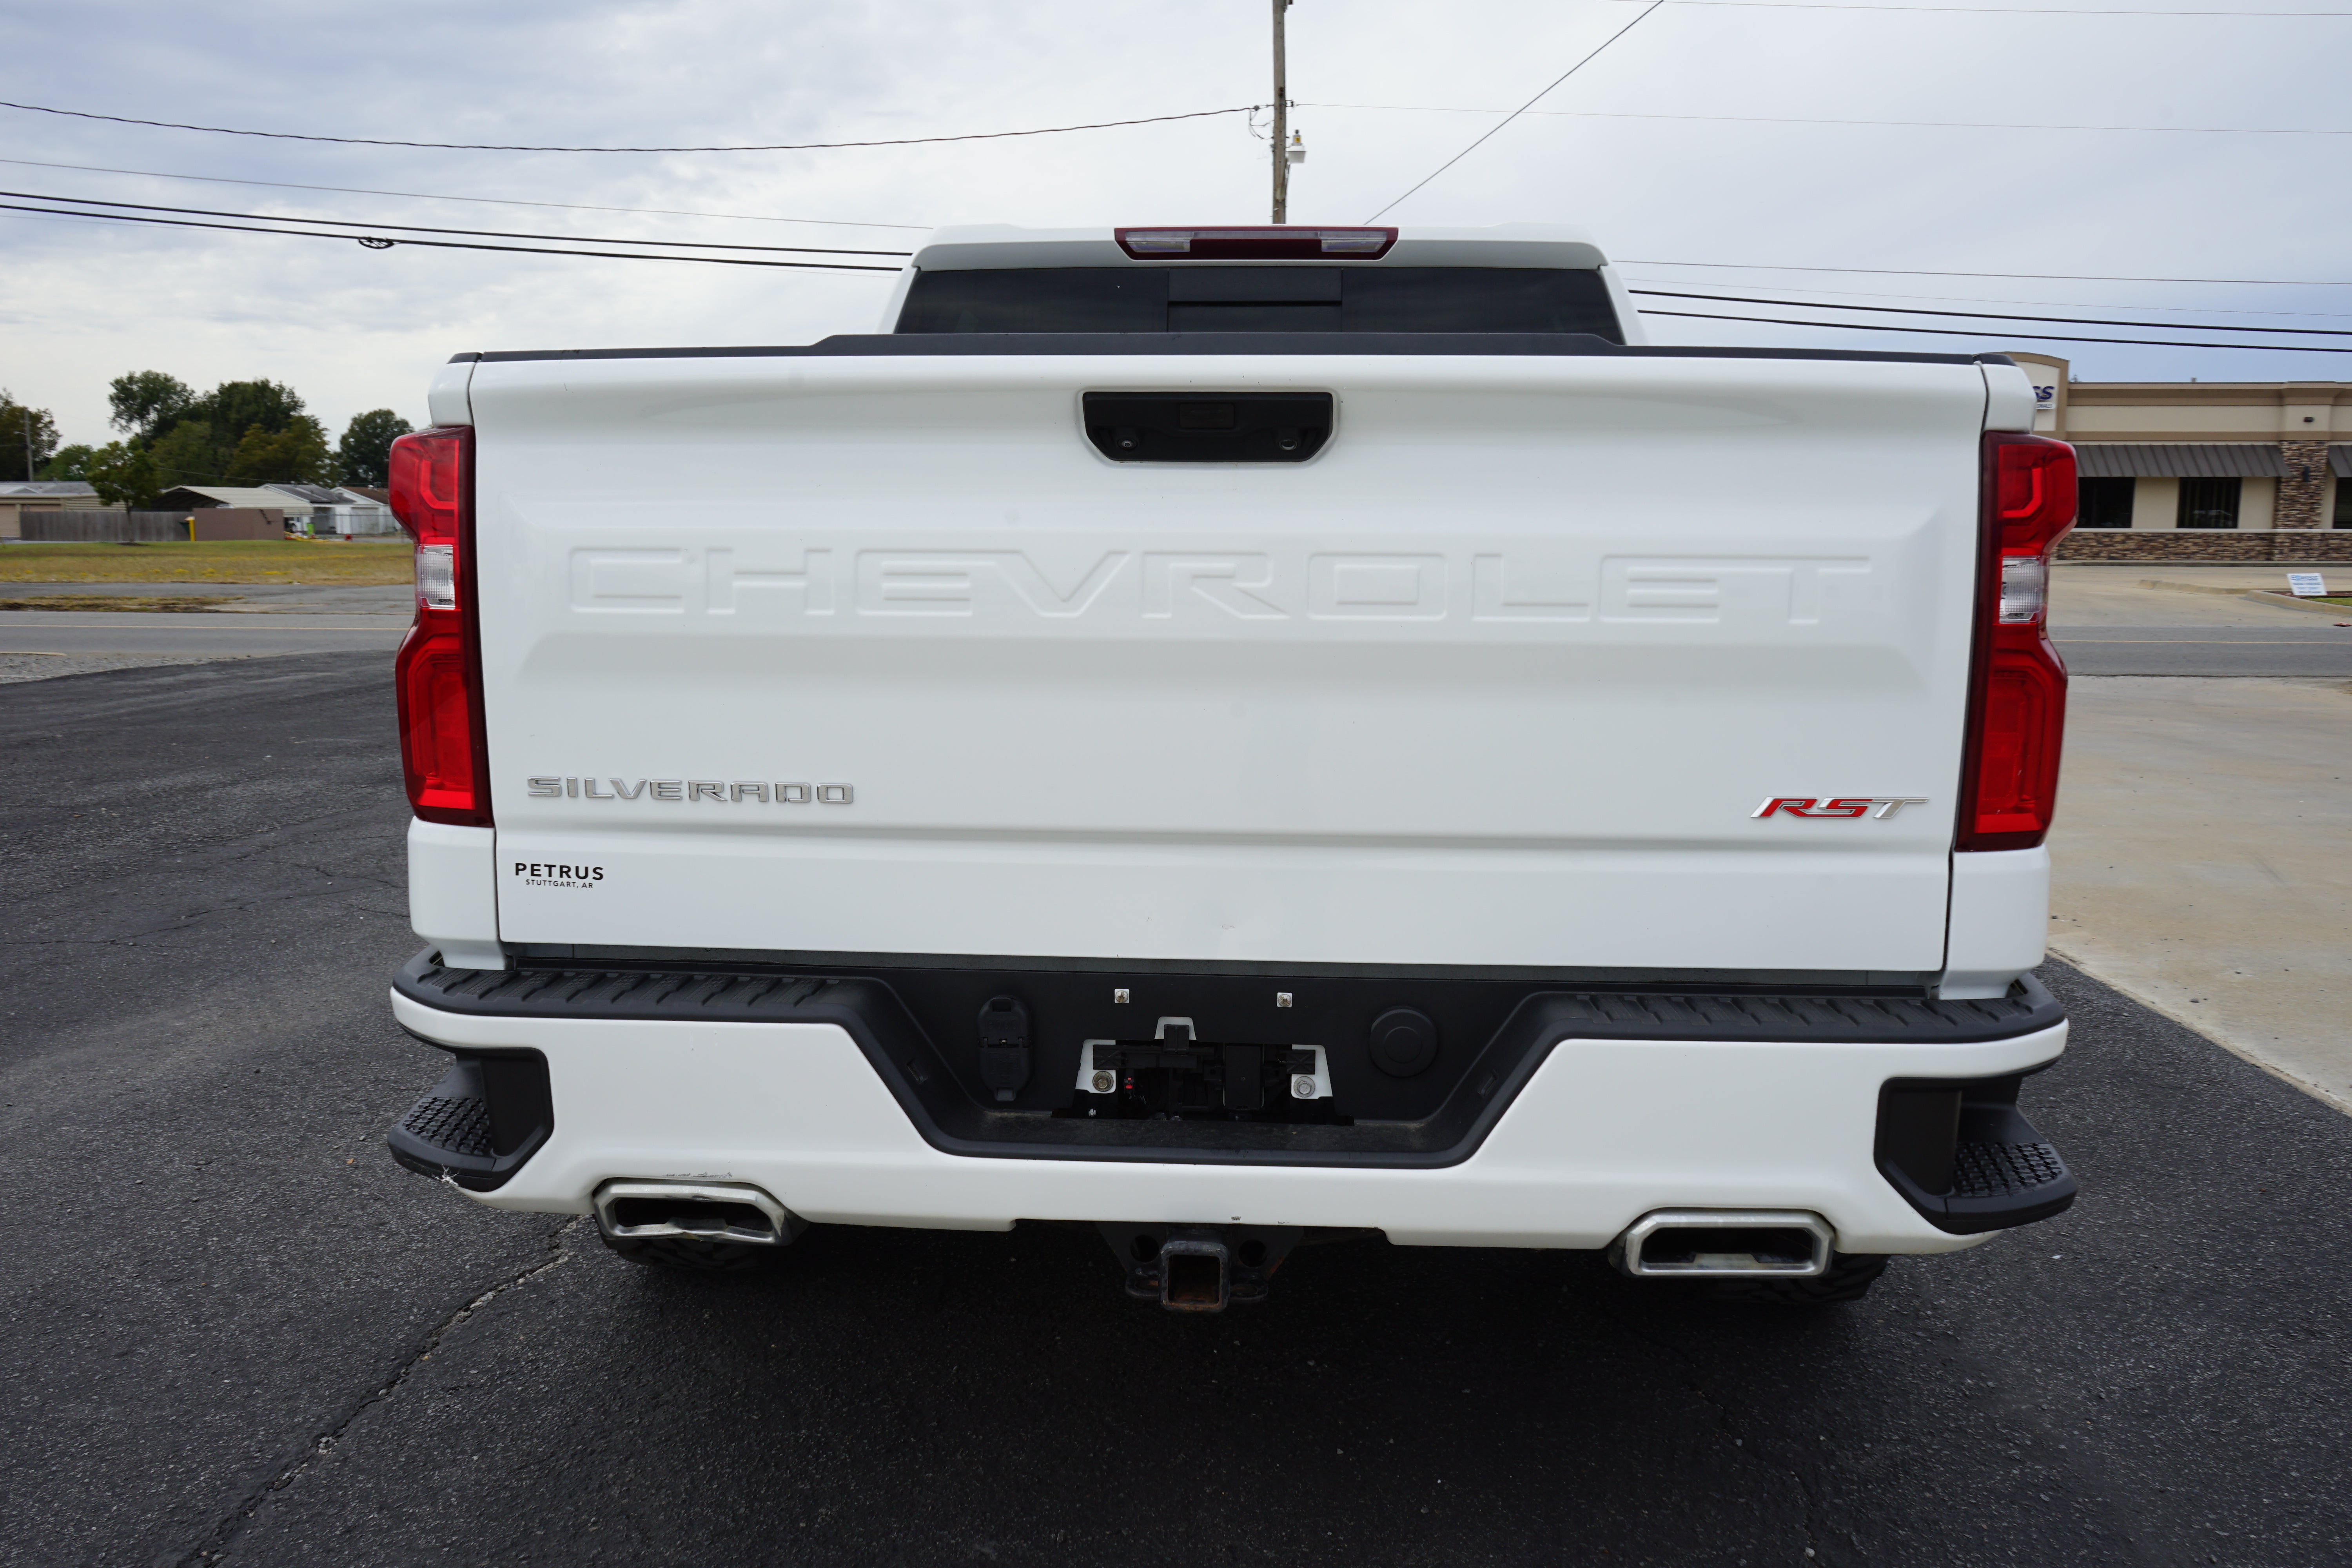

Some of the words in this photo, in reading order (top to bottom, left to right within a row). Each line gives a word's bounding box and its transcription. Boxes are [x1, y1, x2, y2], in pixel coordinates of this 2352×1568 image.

[569, 547, 1871, 624] CHEVROLET
[527, 776, 855, 804] SILVERADO
[1750, 796, 1930, 818] RST
[515, 862, 604, 880] PETRUS
[525, 879, 579, 889] STUTTGART,
